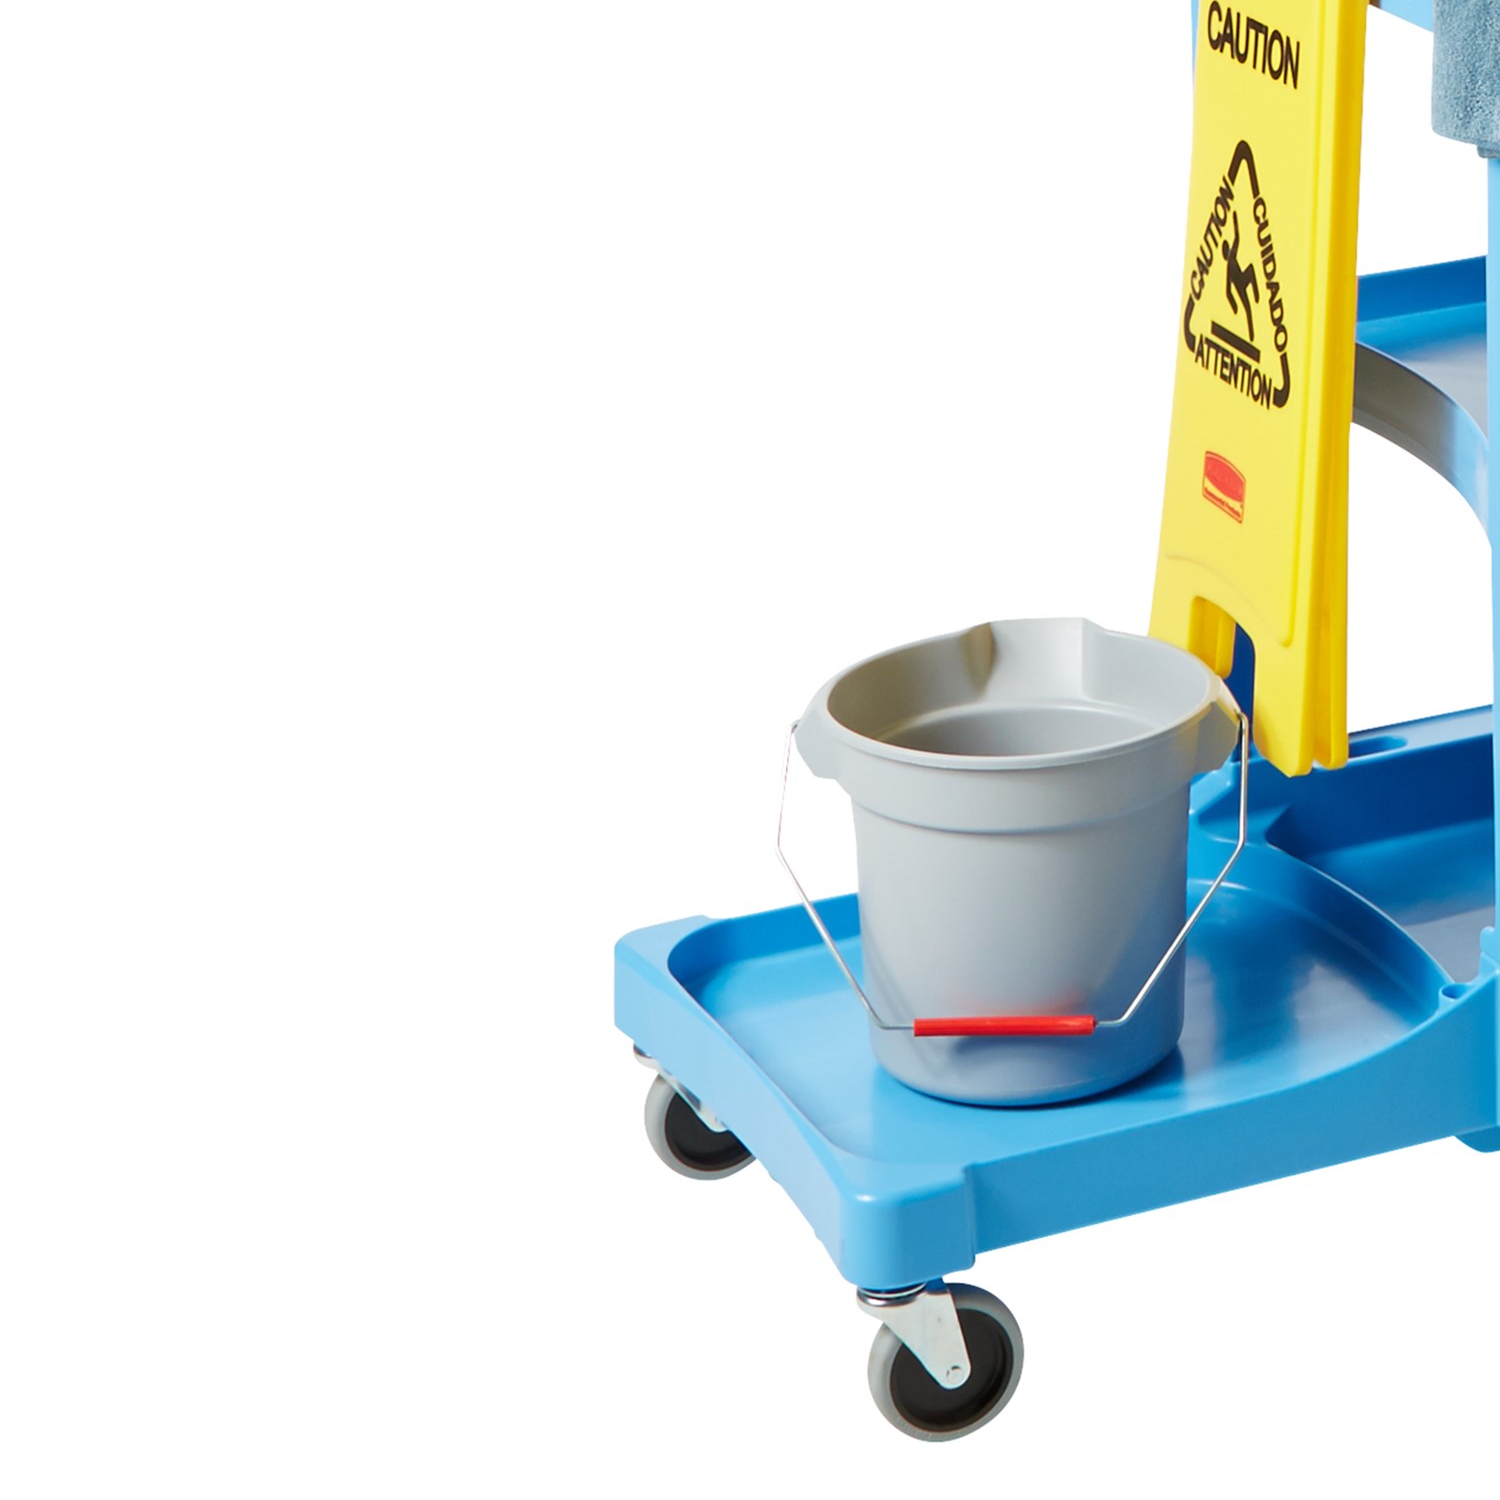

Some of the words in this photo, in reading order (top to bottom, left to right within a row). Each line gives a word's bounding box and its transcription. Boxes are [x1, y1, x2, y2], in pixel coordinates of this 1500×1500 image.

[1207, 0, 1300, 89] CAUTION
[1190, 175, 1235, 301] CAUTION
[1253, 196, 1288, 352] CUIDADO
[1195, 333, 1272, 410] ATTENTION
